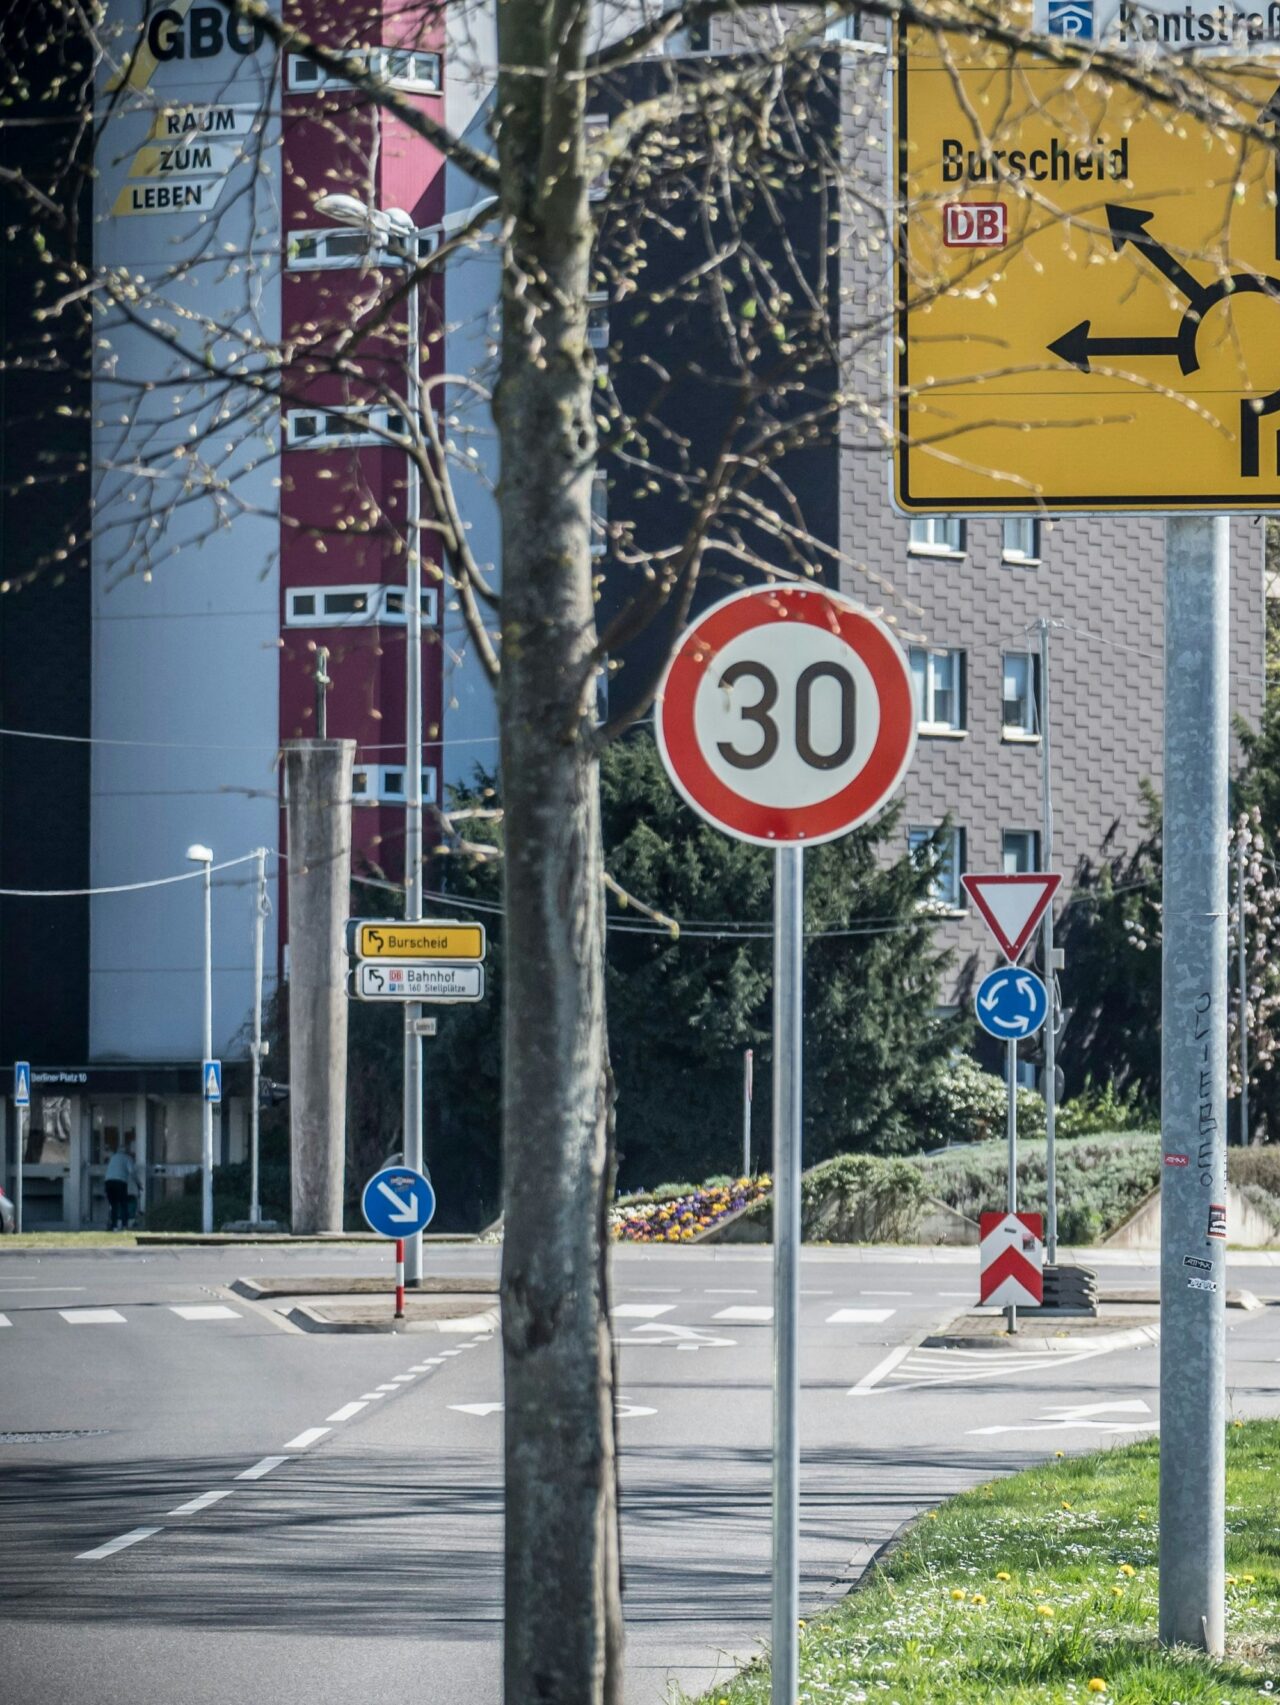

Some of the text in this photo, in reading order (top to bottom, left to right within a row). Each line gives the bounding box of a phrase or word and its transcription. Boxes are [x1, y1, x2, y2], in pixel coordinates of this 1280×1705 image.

[167, 108, 236, 135] RAUM
[159, 150, 212, 172] ZUM
[943, 137, 1128, 182] Burscheid
[132, 185, 203, 210] LEBEN
[950, 209, 1000, 241] DB
[716, 660, 857, 771] 30
[388, 935, 448, 949] Burscheid
[407, 970, 455, 982] Bahnhof
[409, 983, 466, 993] 160 Stellplätze
[60, 1072, 77, 1082] Platz
